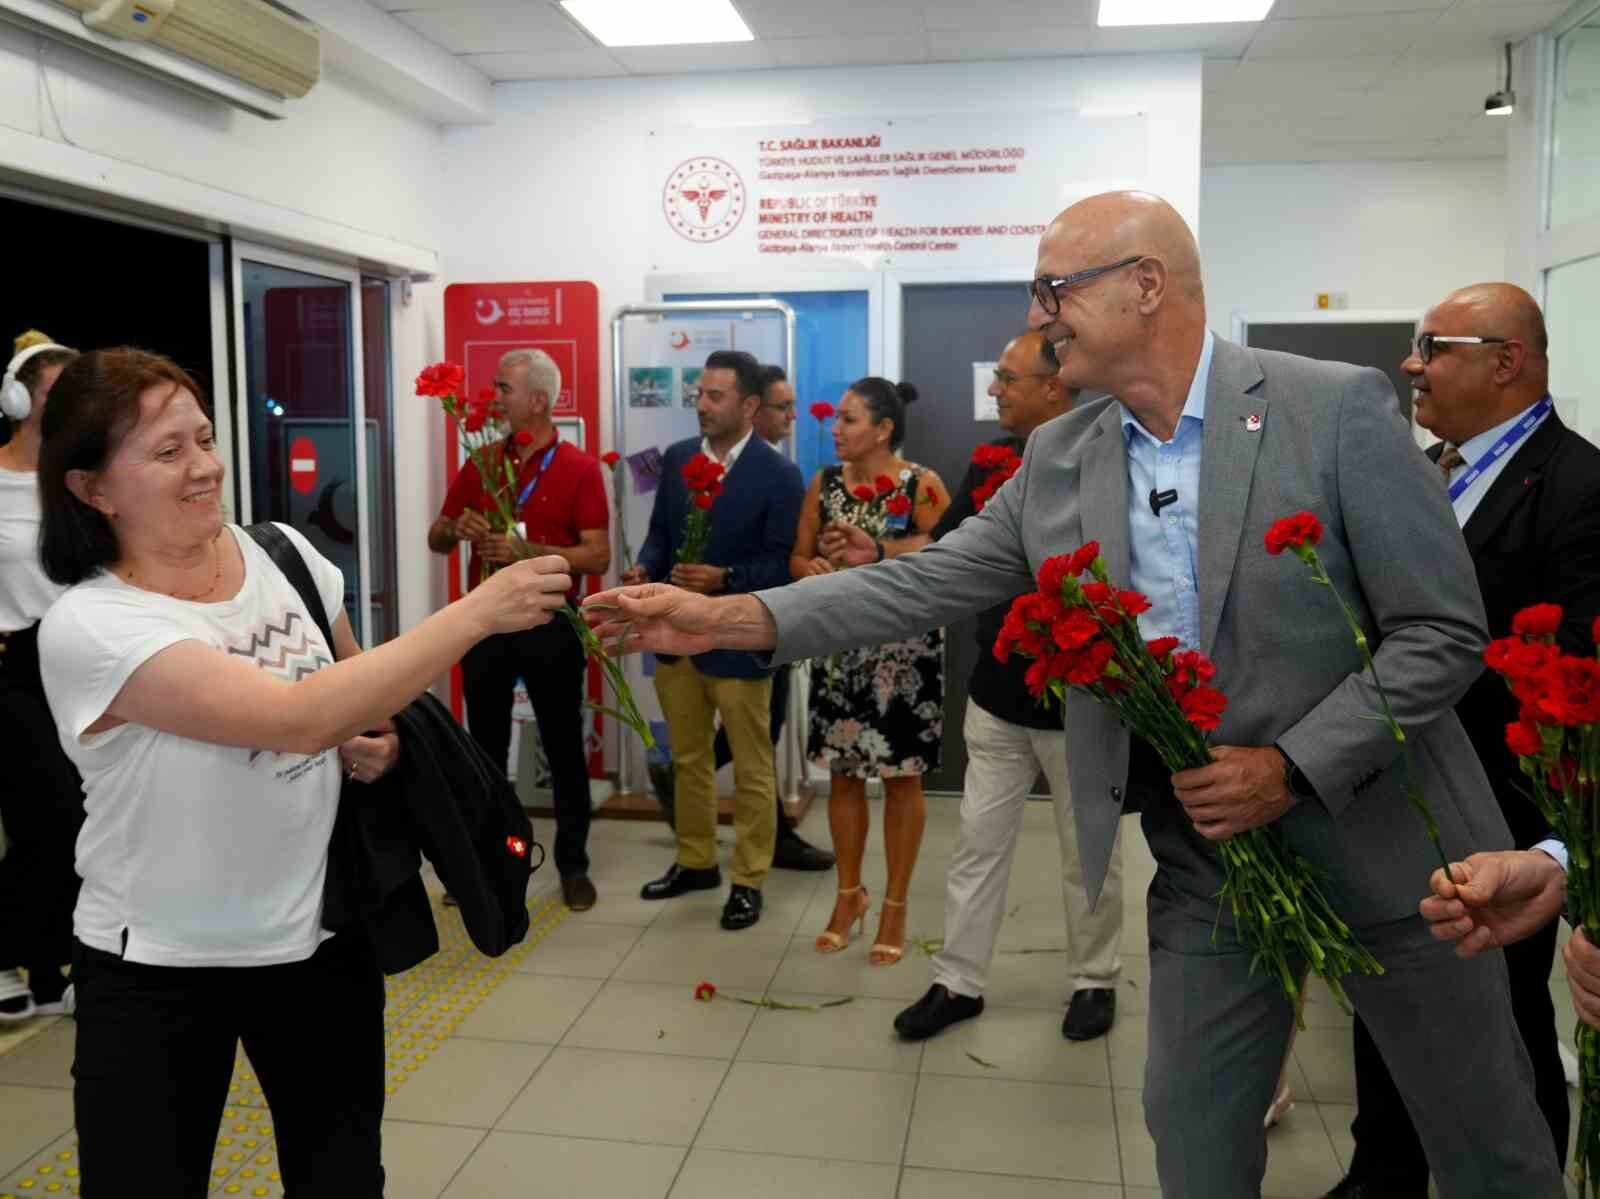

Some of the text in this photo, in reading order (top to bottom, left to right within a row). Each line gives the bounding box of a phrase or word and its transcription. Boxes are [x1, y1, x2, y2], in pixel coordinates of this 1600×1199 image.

[779, 138, 818, 151] SAĞLIK
[821, 135, 881, 149] BAKANLIĞI
[759, 210, 872, 224] MINISTRY OF HEALTH
[759, 229, 799, 239] GENERAL
[865, 227, 878, 237] OF
[920, 226, 938, 235] FOR
[987, 225, 1007, 235] AND
